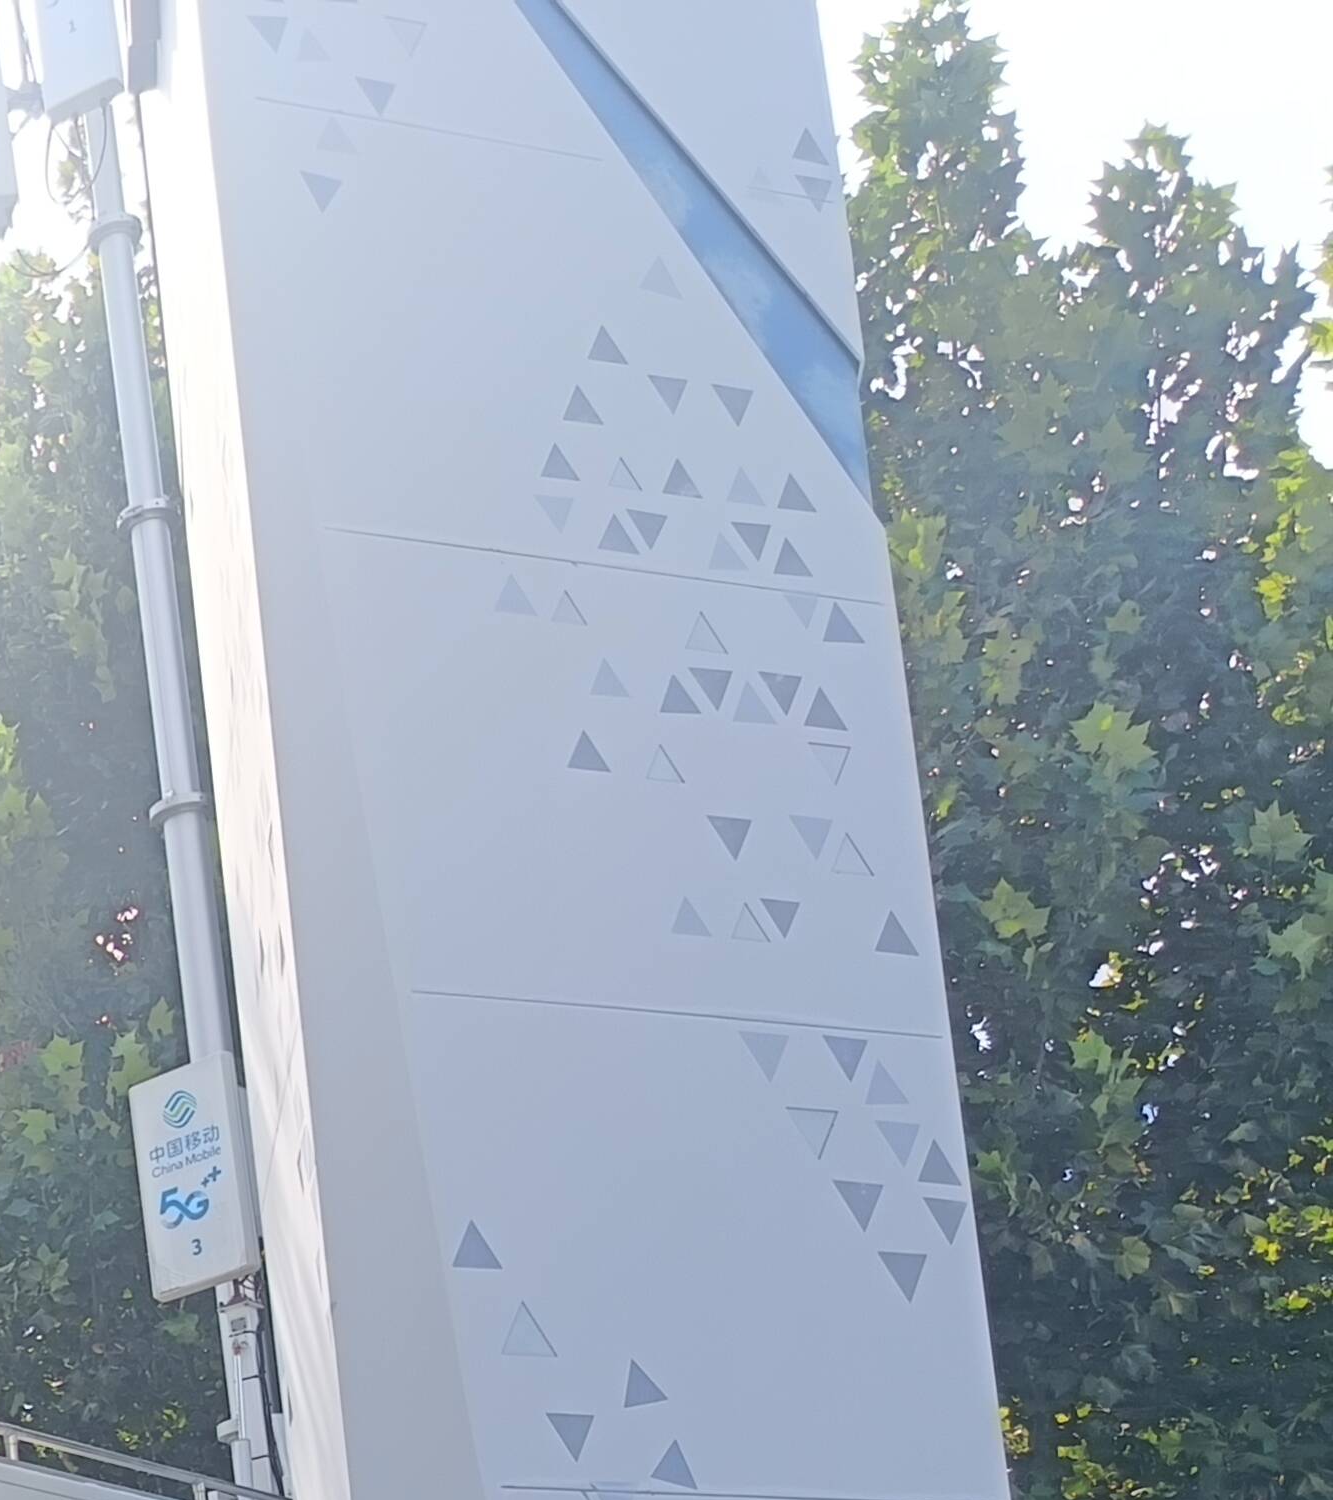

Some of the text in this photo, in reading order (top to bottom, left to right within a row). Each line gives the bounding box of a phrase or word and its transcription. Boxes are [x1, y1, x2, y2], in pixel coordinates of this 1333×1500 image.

[149, 1124, 220, 1164] 中国移动
[151, 1145, 222, 1179] China Mobile
[191, 1238, 203, 1256] 3
